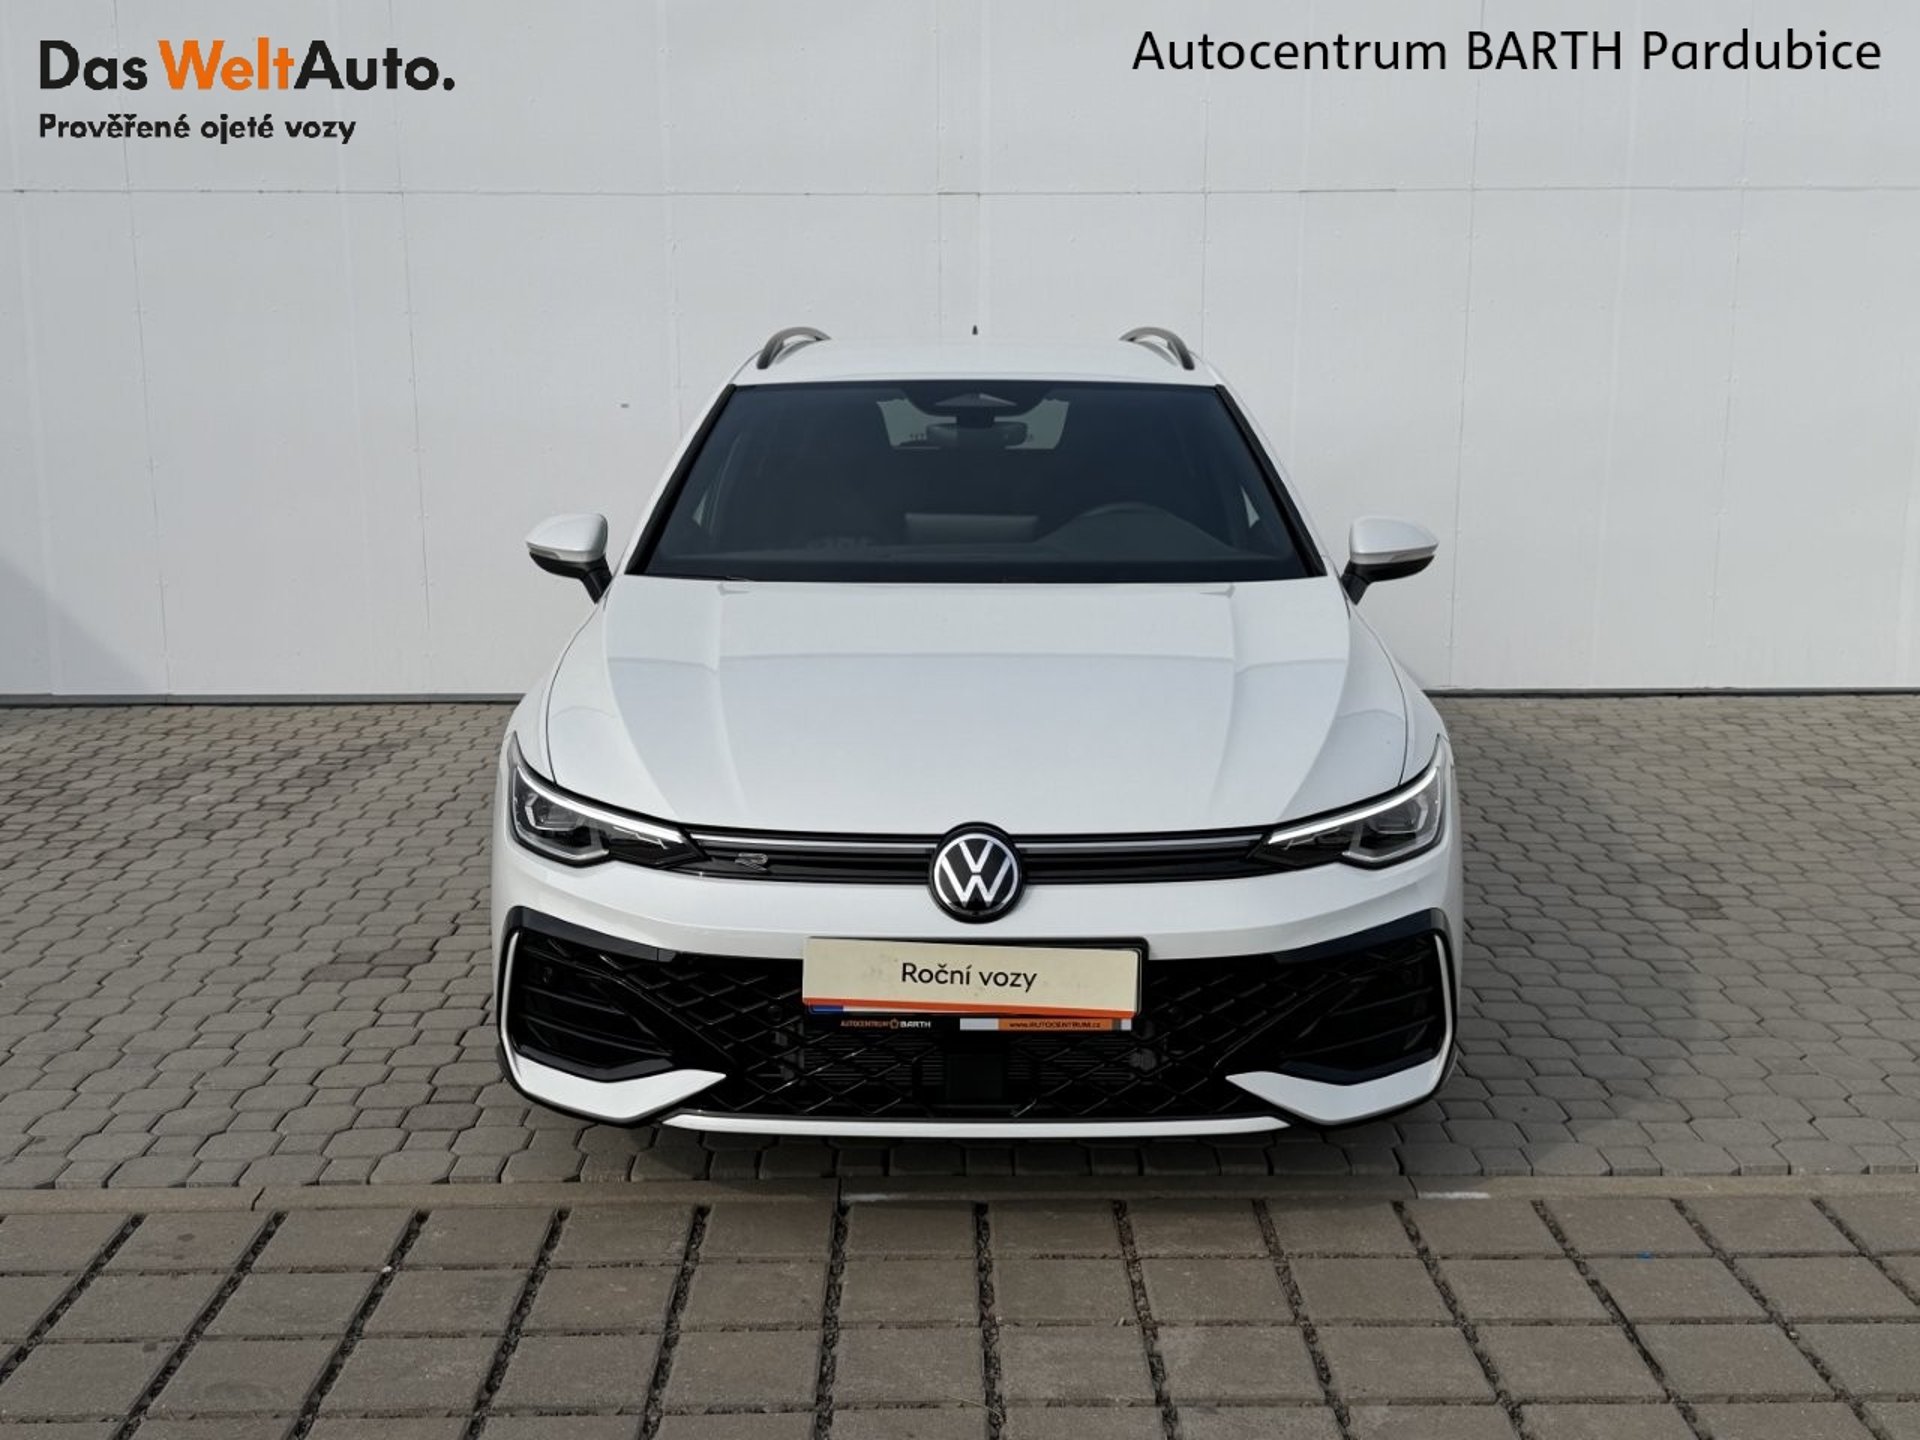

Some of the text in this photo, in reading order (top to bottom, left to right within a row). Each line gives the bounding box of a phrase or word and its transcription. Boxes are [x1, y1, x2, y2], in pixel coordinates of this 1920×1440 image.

[901, 962, 1038, 994] Roční vozy
[899, 1020, 931, 1028] BARTH
